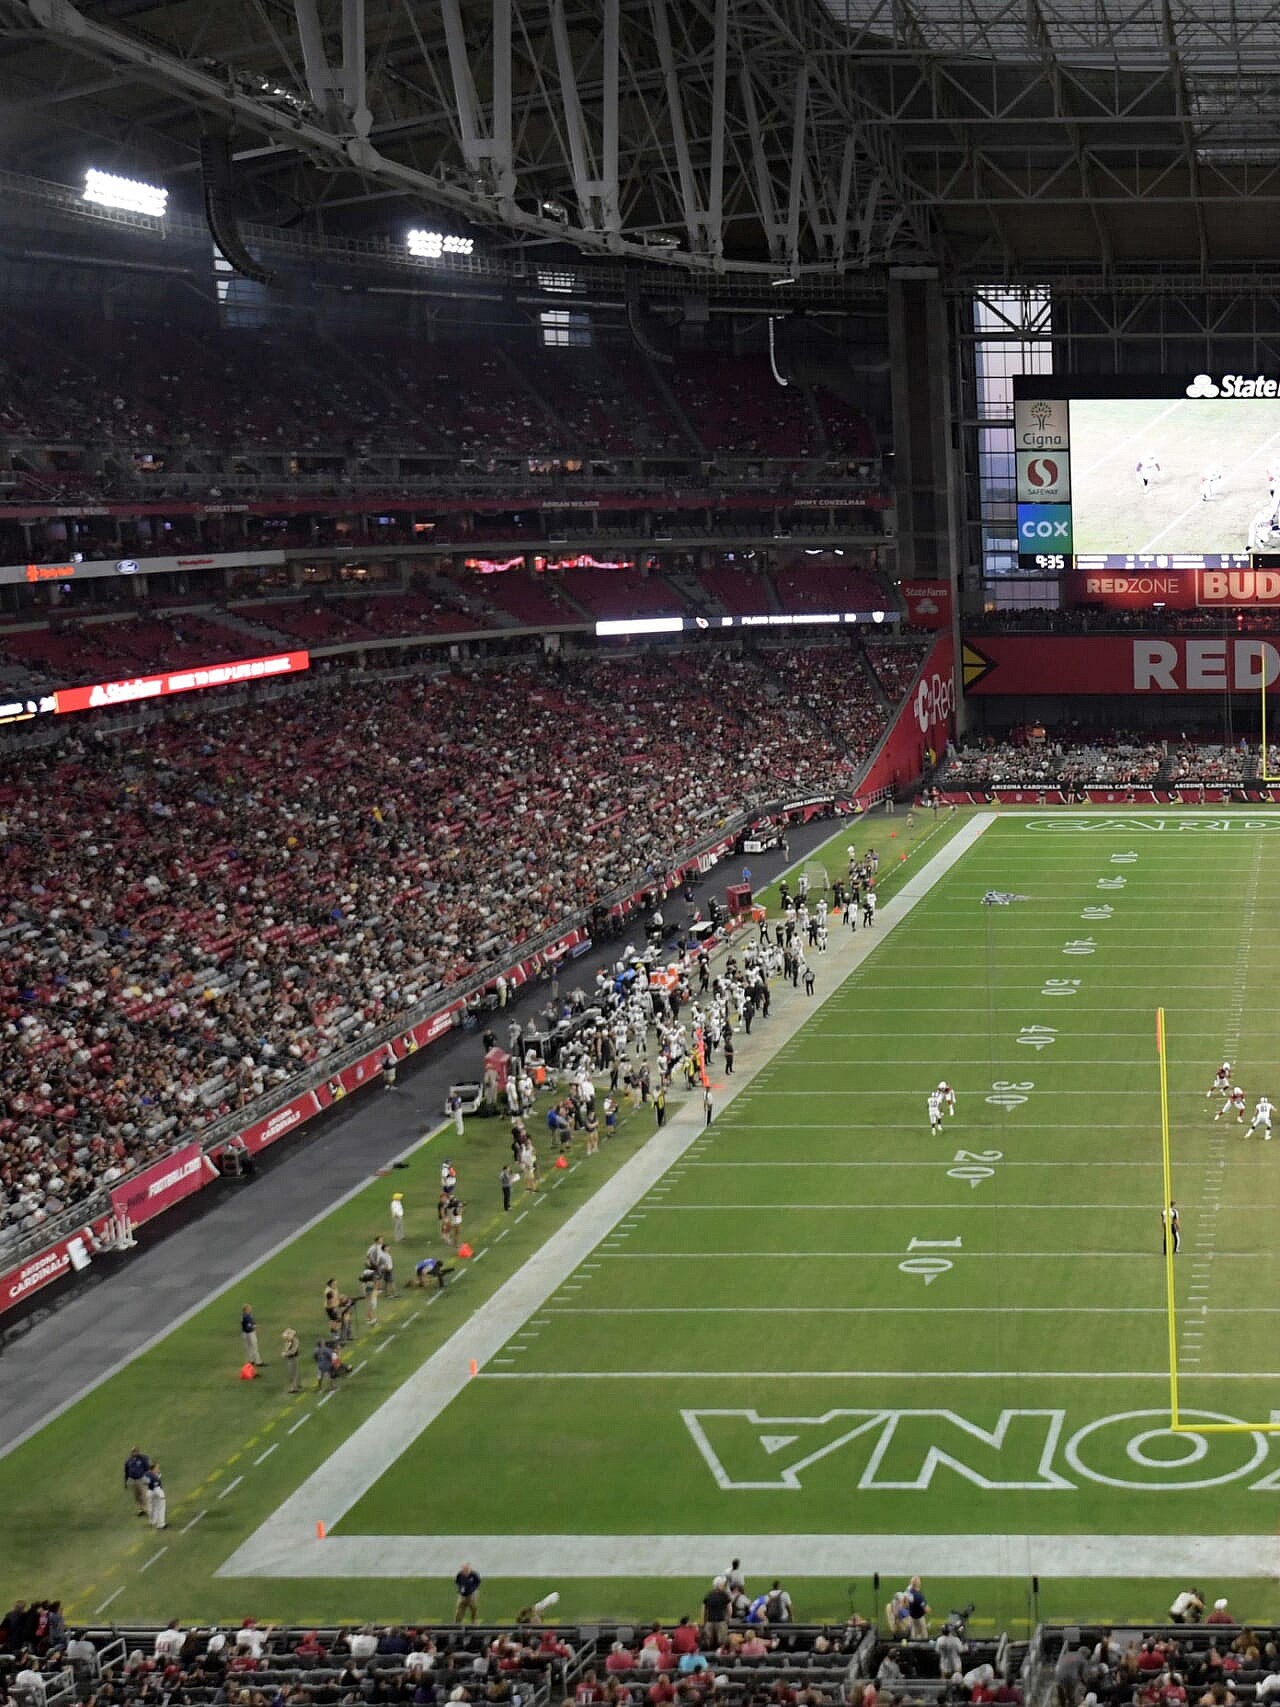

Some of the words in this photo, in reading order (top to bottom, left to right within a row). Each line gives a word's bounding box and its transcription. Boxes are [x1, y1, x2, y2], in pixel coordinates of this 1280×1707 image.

[1023, 433, 1061, 448] Cigna
[1022, 521, 1068, 537] COX
[1036, 555, 1064, 569] 9:35
[1110, 852, 1138, 863] 10
[1096, 876, 1127, 889] 20
[1080, 906, 1114, 919] 30
[1062, 939, 1097, 954] 40
[1041, 979, 1081, 995] 50
[1016, 1025, 1059, 1044] 40
[985, 1081, 1034, 1104] 30
[947, 1150, 1003, 1179] 20
[898, 1236, 962, 1273] 10
[21, 1252, 57, 1279] ARIZONA
[9, 1254, 70, 1298] CARDINALS
